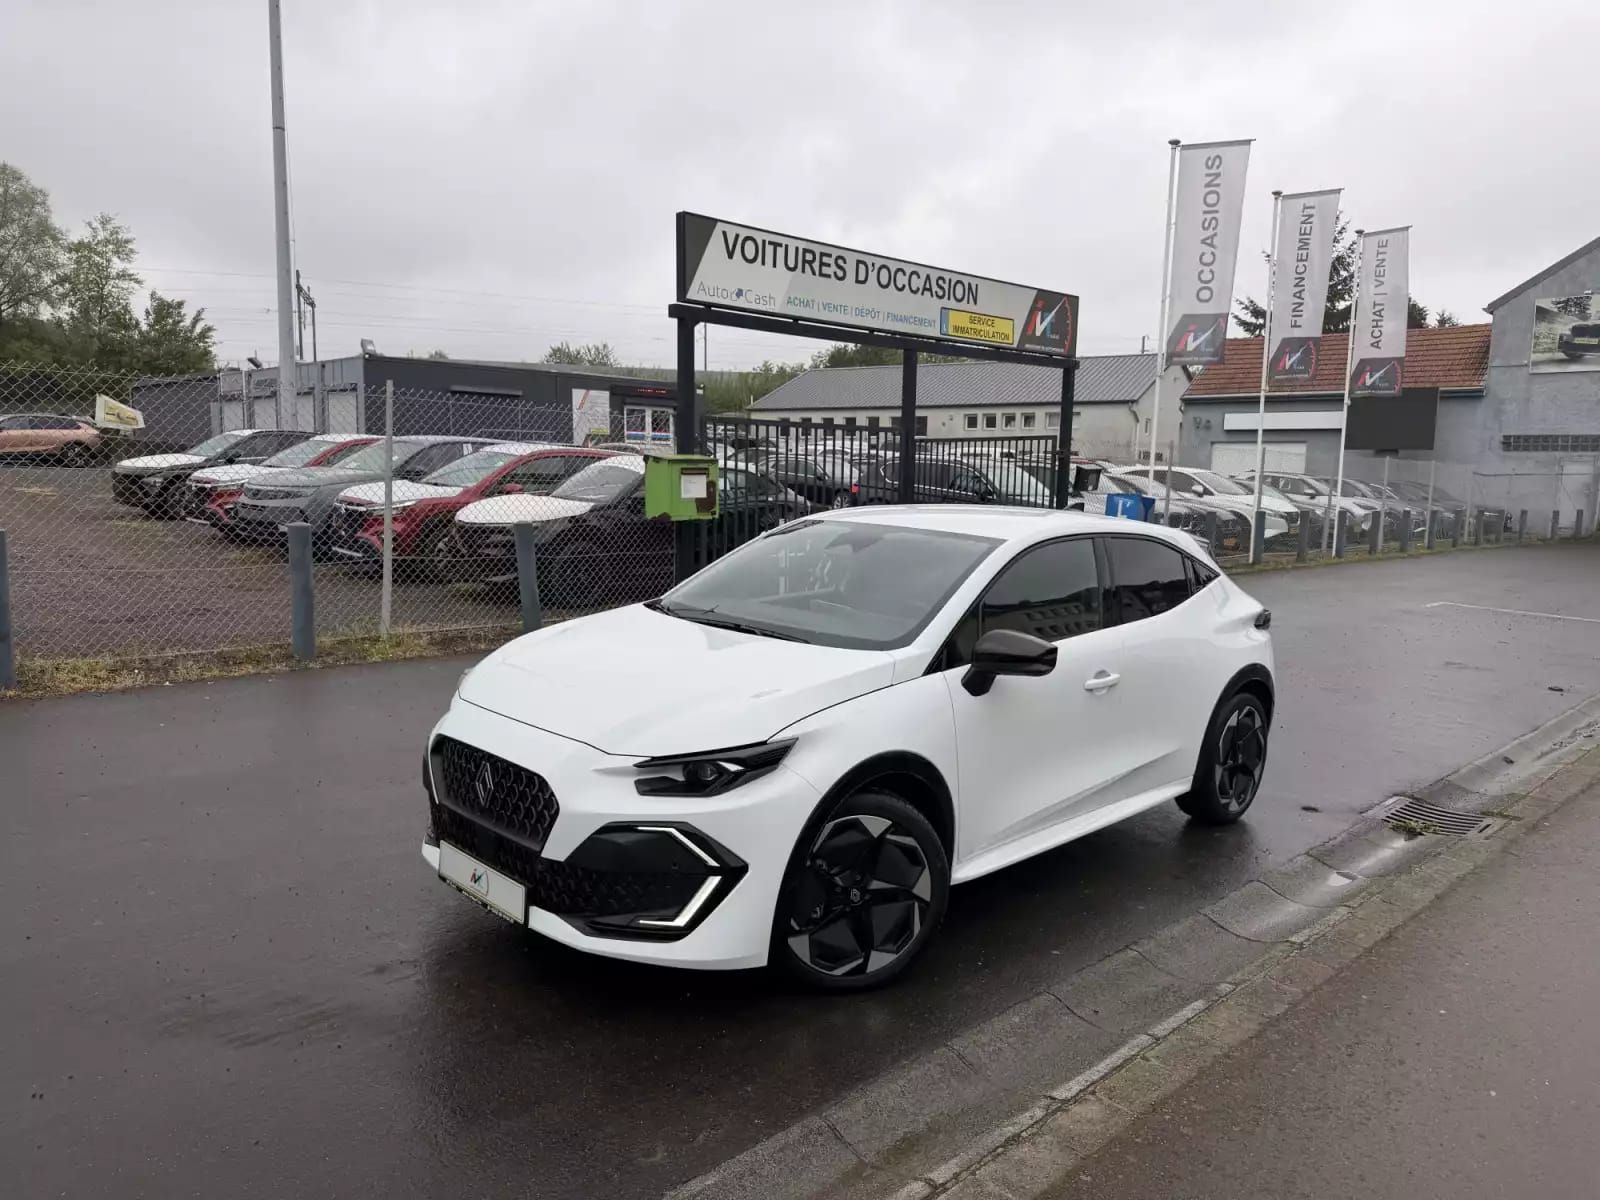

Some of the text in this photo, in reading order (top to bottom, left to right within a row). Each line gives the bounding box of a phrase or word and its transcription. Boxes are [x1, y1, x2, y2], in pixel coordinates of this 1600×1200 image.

[1196, 153, 1223, 304] OCCASIONS
[722, 230, 848, 282] VOITURES
[1290, 202, 1316, 329] FINANCEMENT
[786, 296, 816, 310] ACHAT
[822, 302, 849, 315] VENTE
[886, 311, 937, 329] FINANCEMENT
[1370, 238, 1389, 350] ACHAT VENTE
[952, 325, 1010, 341] IMMATRICULATION
[968, 314, 996, 328] SERVICE
